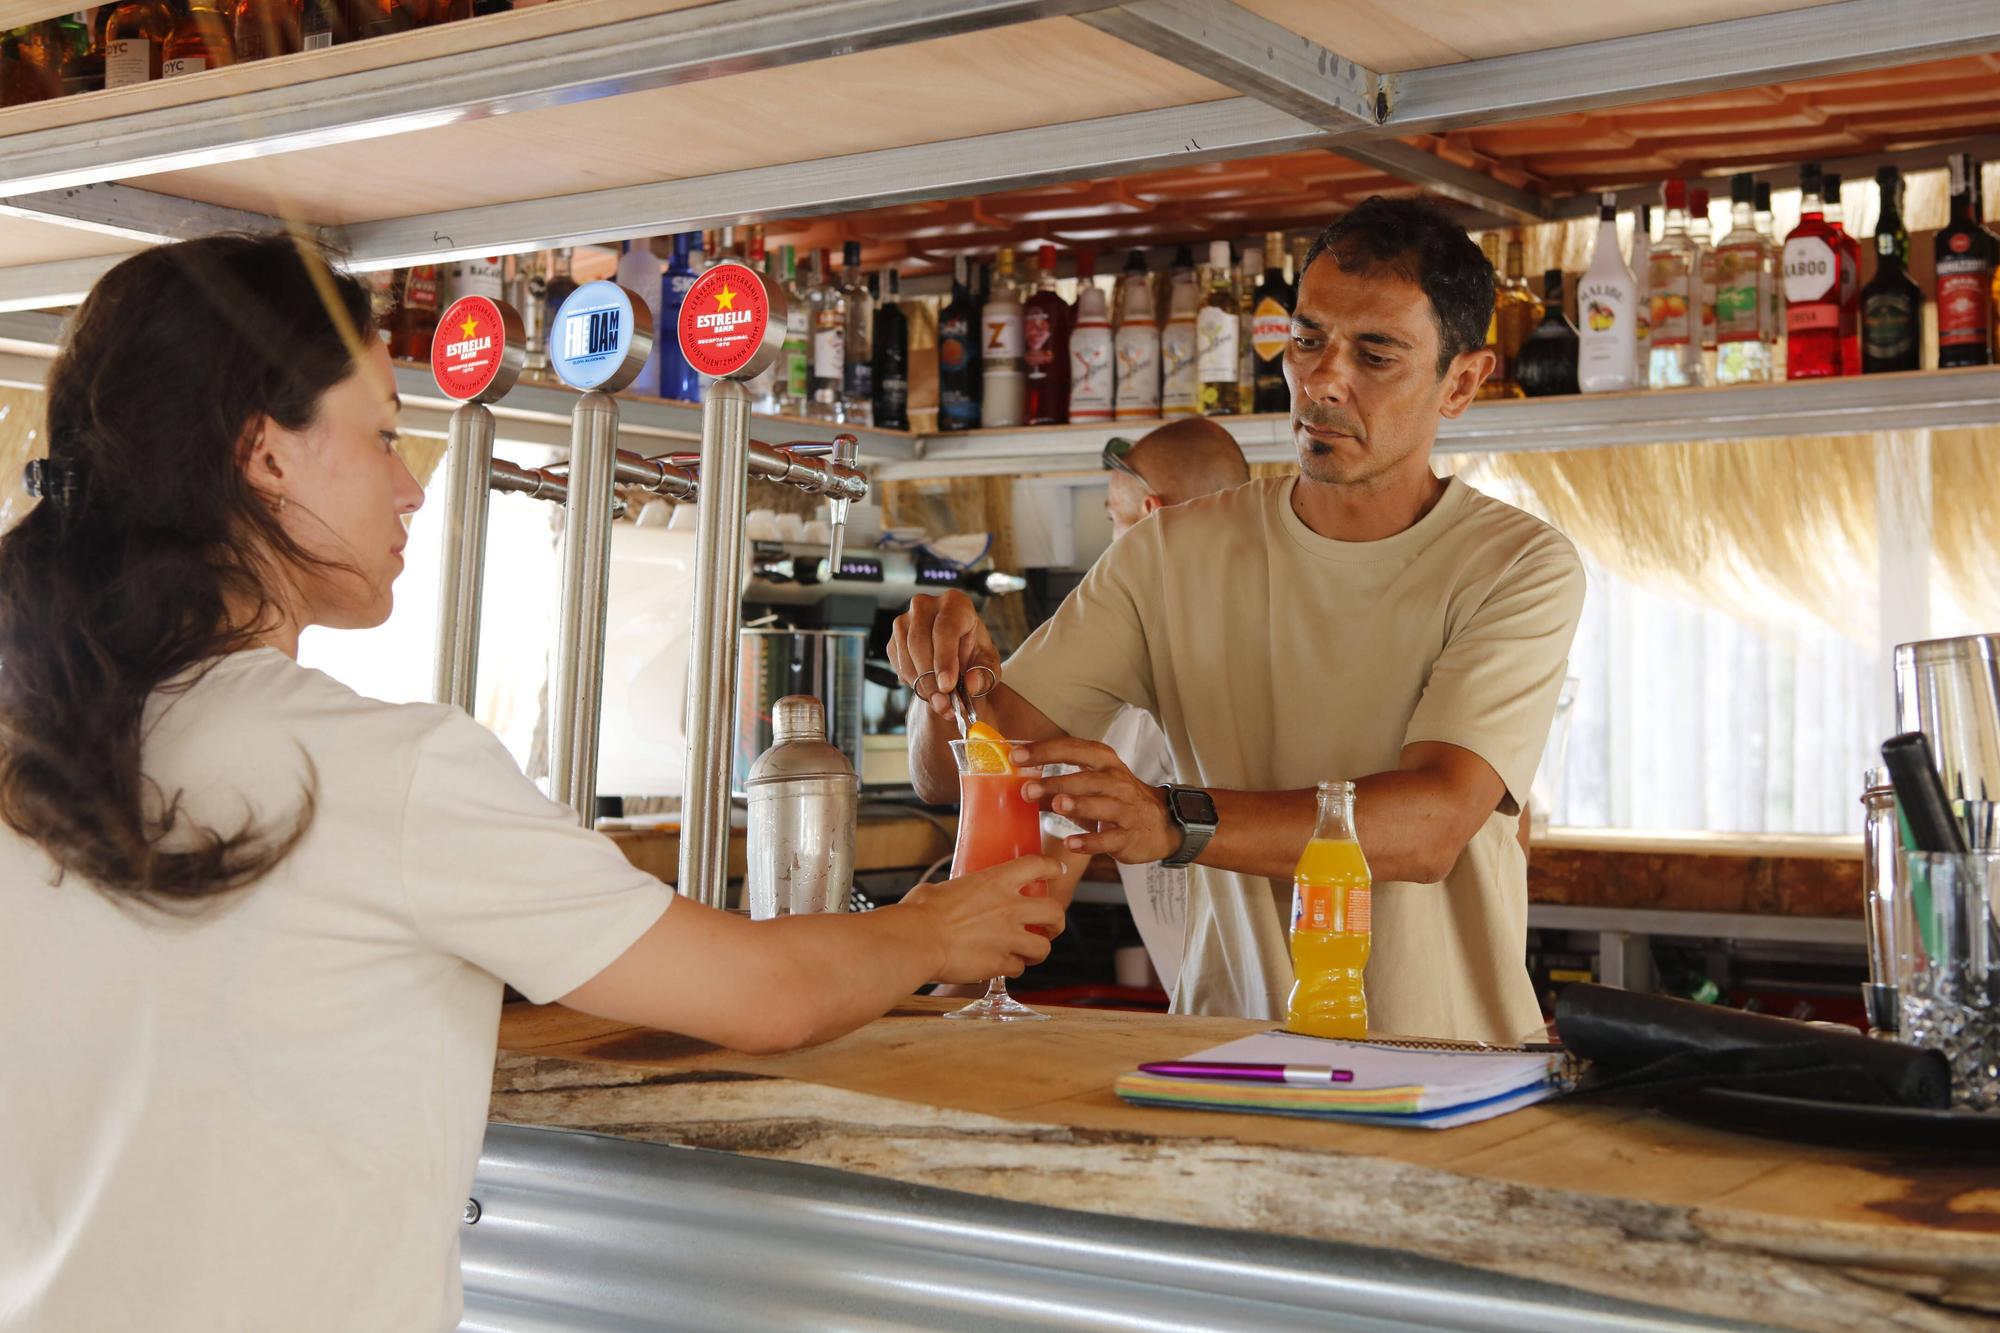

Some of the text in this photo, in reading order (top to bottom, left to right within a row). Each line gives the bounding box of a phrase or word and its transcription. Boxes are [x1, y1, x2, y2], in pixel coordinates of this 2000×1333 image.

[697, 310, 752, 328] ESTRELLA
[714, 325, 734, 333] DAMM
[446, 336, 492, 357] ESTRELLA
[460, 351, 477, 360] DAMM
